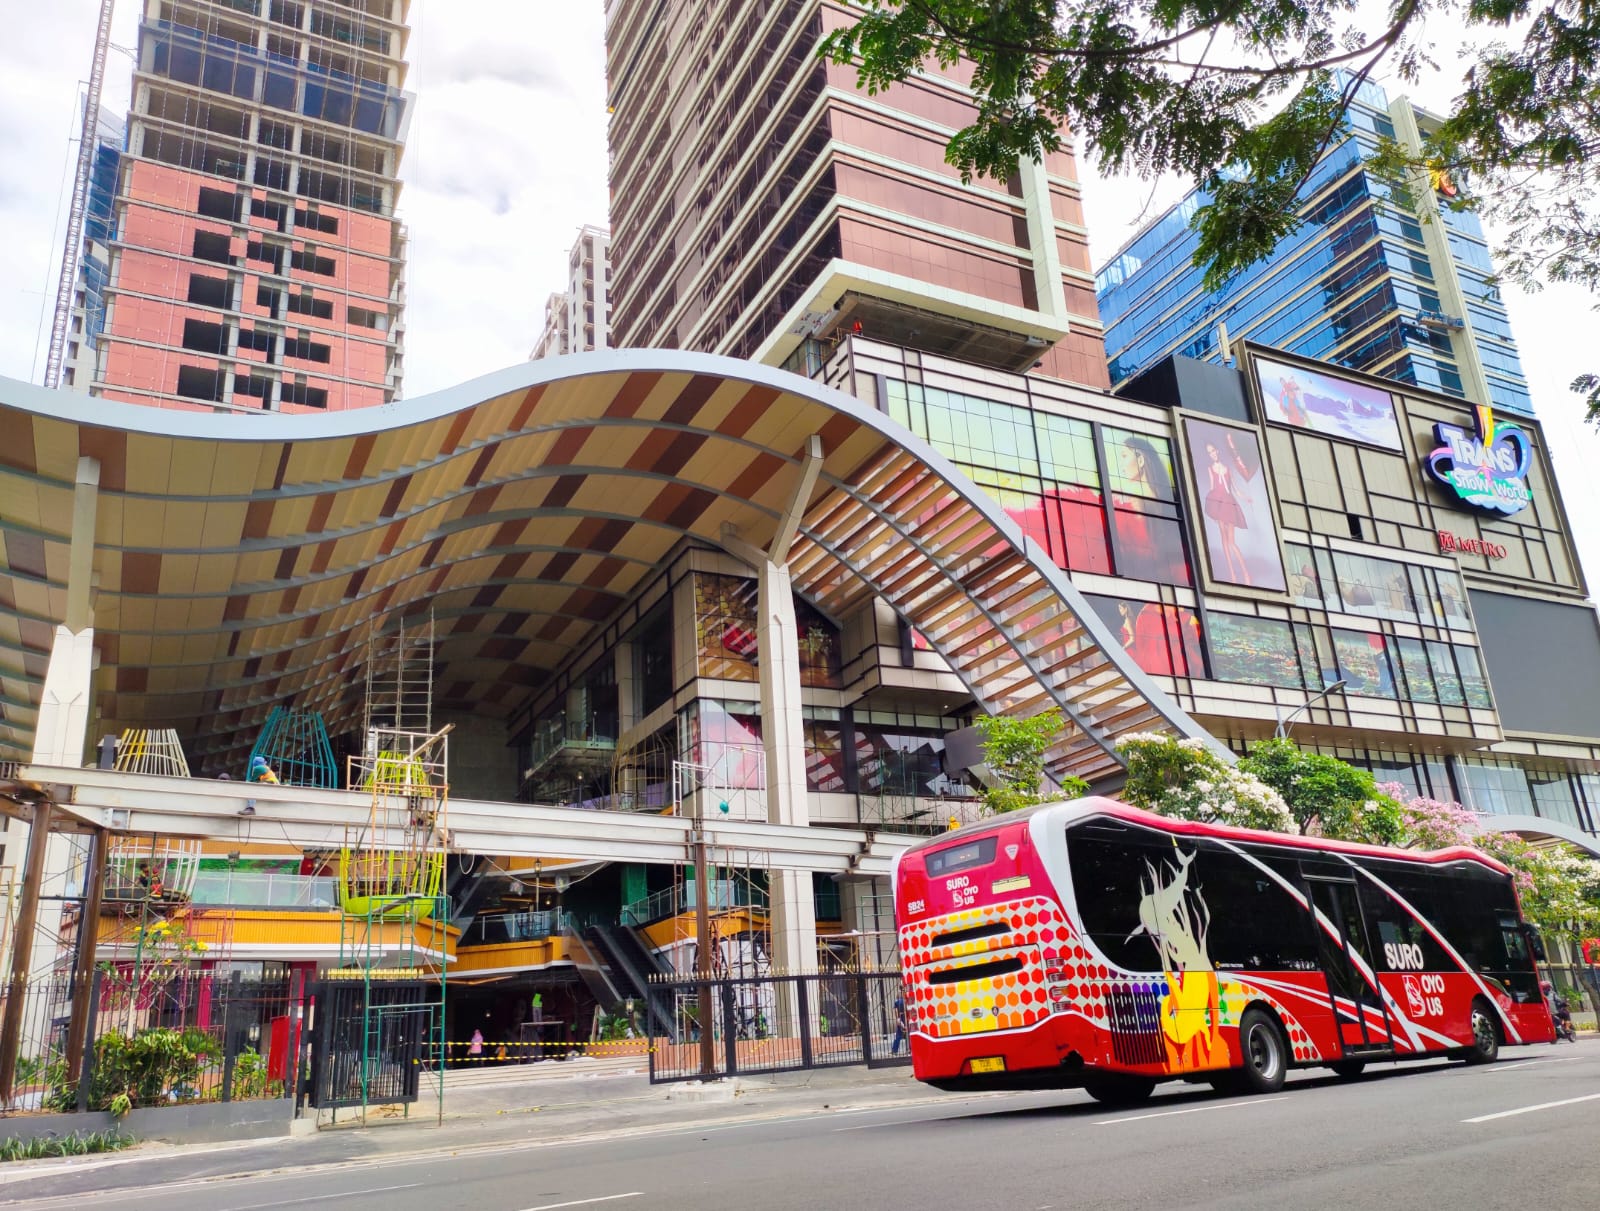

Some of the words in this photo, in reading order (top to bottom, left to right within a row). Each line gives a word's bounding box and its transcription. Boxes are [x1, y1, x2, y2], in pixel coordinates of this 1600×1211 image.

[1443, 428, 1514, 472] TRANS
[1460, 538, 1507, 558] METRO
[947, 876, 969, 890] SURO
[1384, 943, 1423, 969] SURO
[1421, 975, 1444, 993] OYO
[1427, 997, 1443, 1016] US
